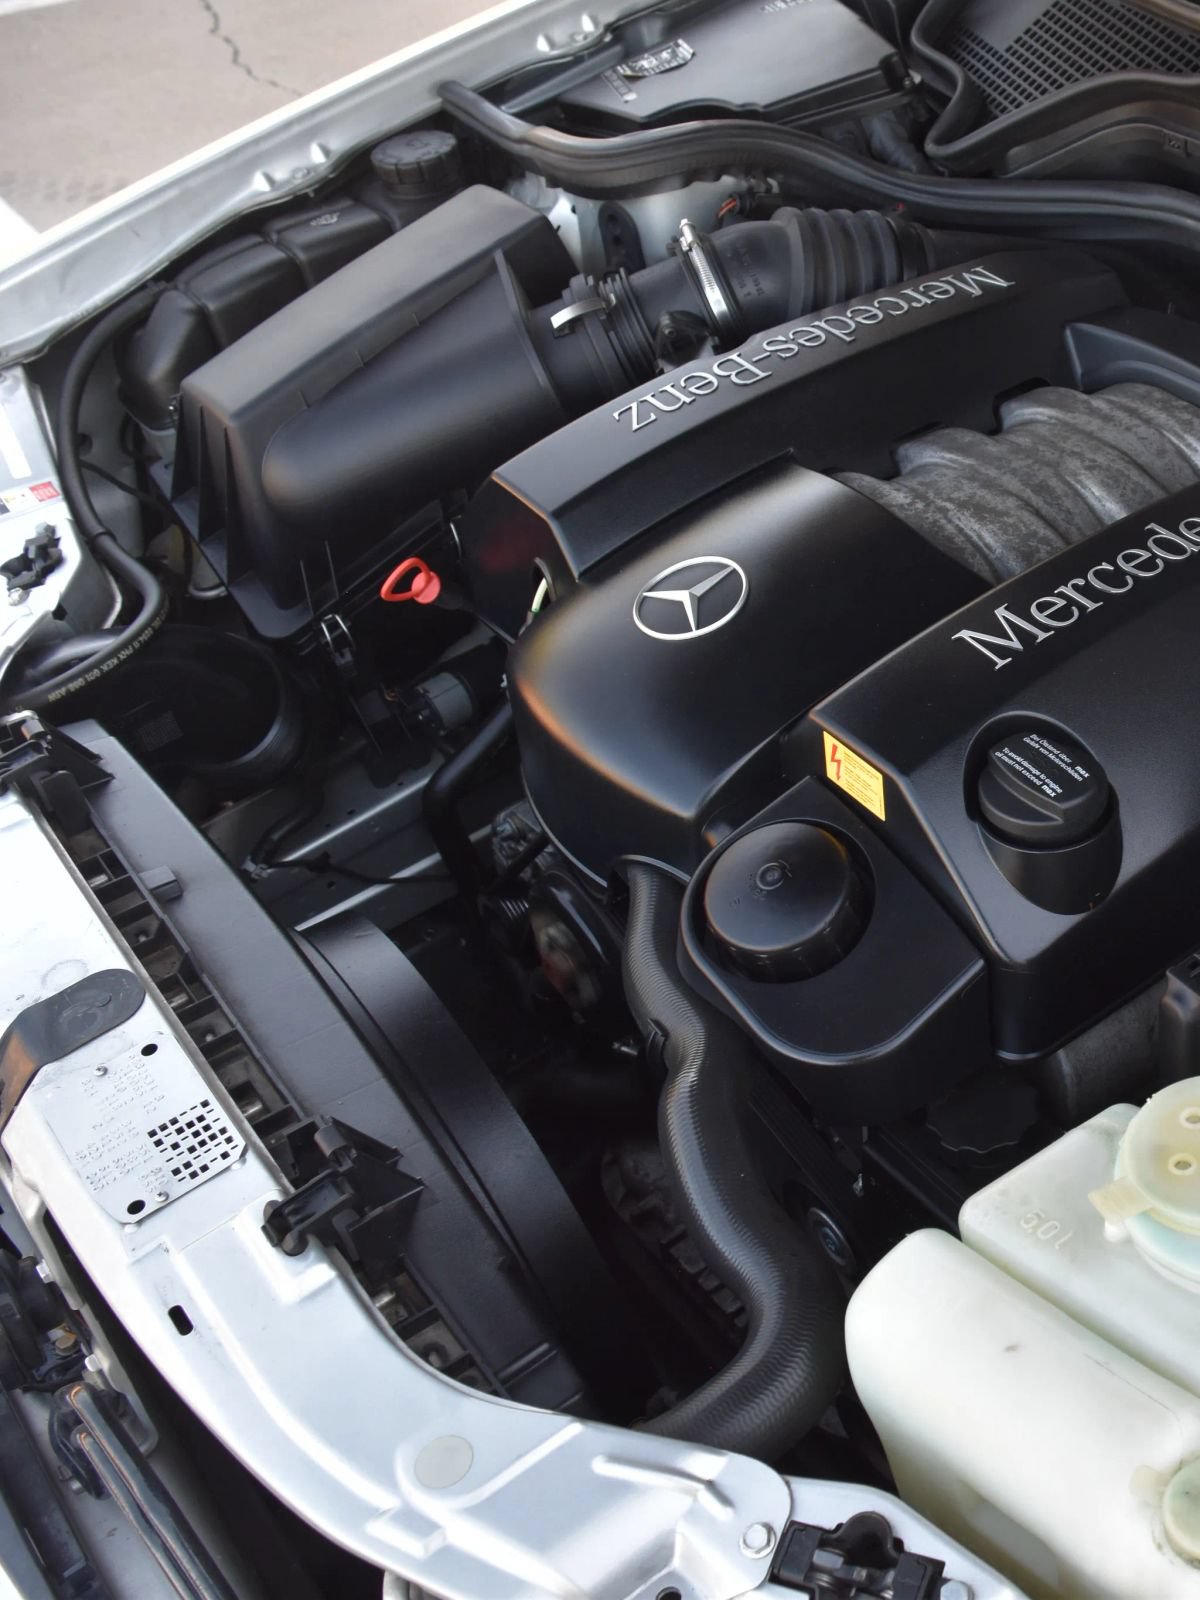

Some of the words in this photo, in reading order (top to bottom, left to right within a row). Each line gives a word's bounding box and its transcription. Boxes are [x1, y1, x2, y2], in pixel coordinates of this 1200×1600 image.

[612, 264, 1016, 433] Mercedes-Benz
[1021, 768, 1043, 786] exceed
[1042, 785, 1056, 797] max
[1075, 766, 1089, 777] max
[1044, 777, 1063, 794] engine
